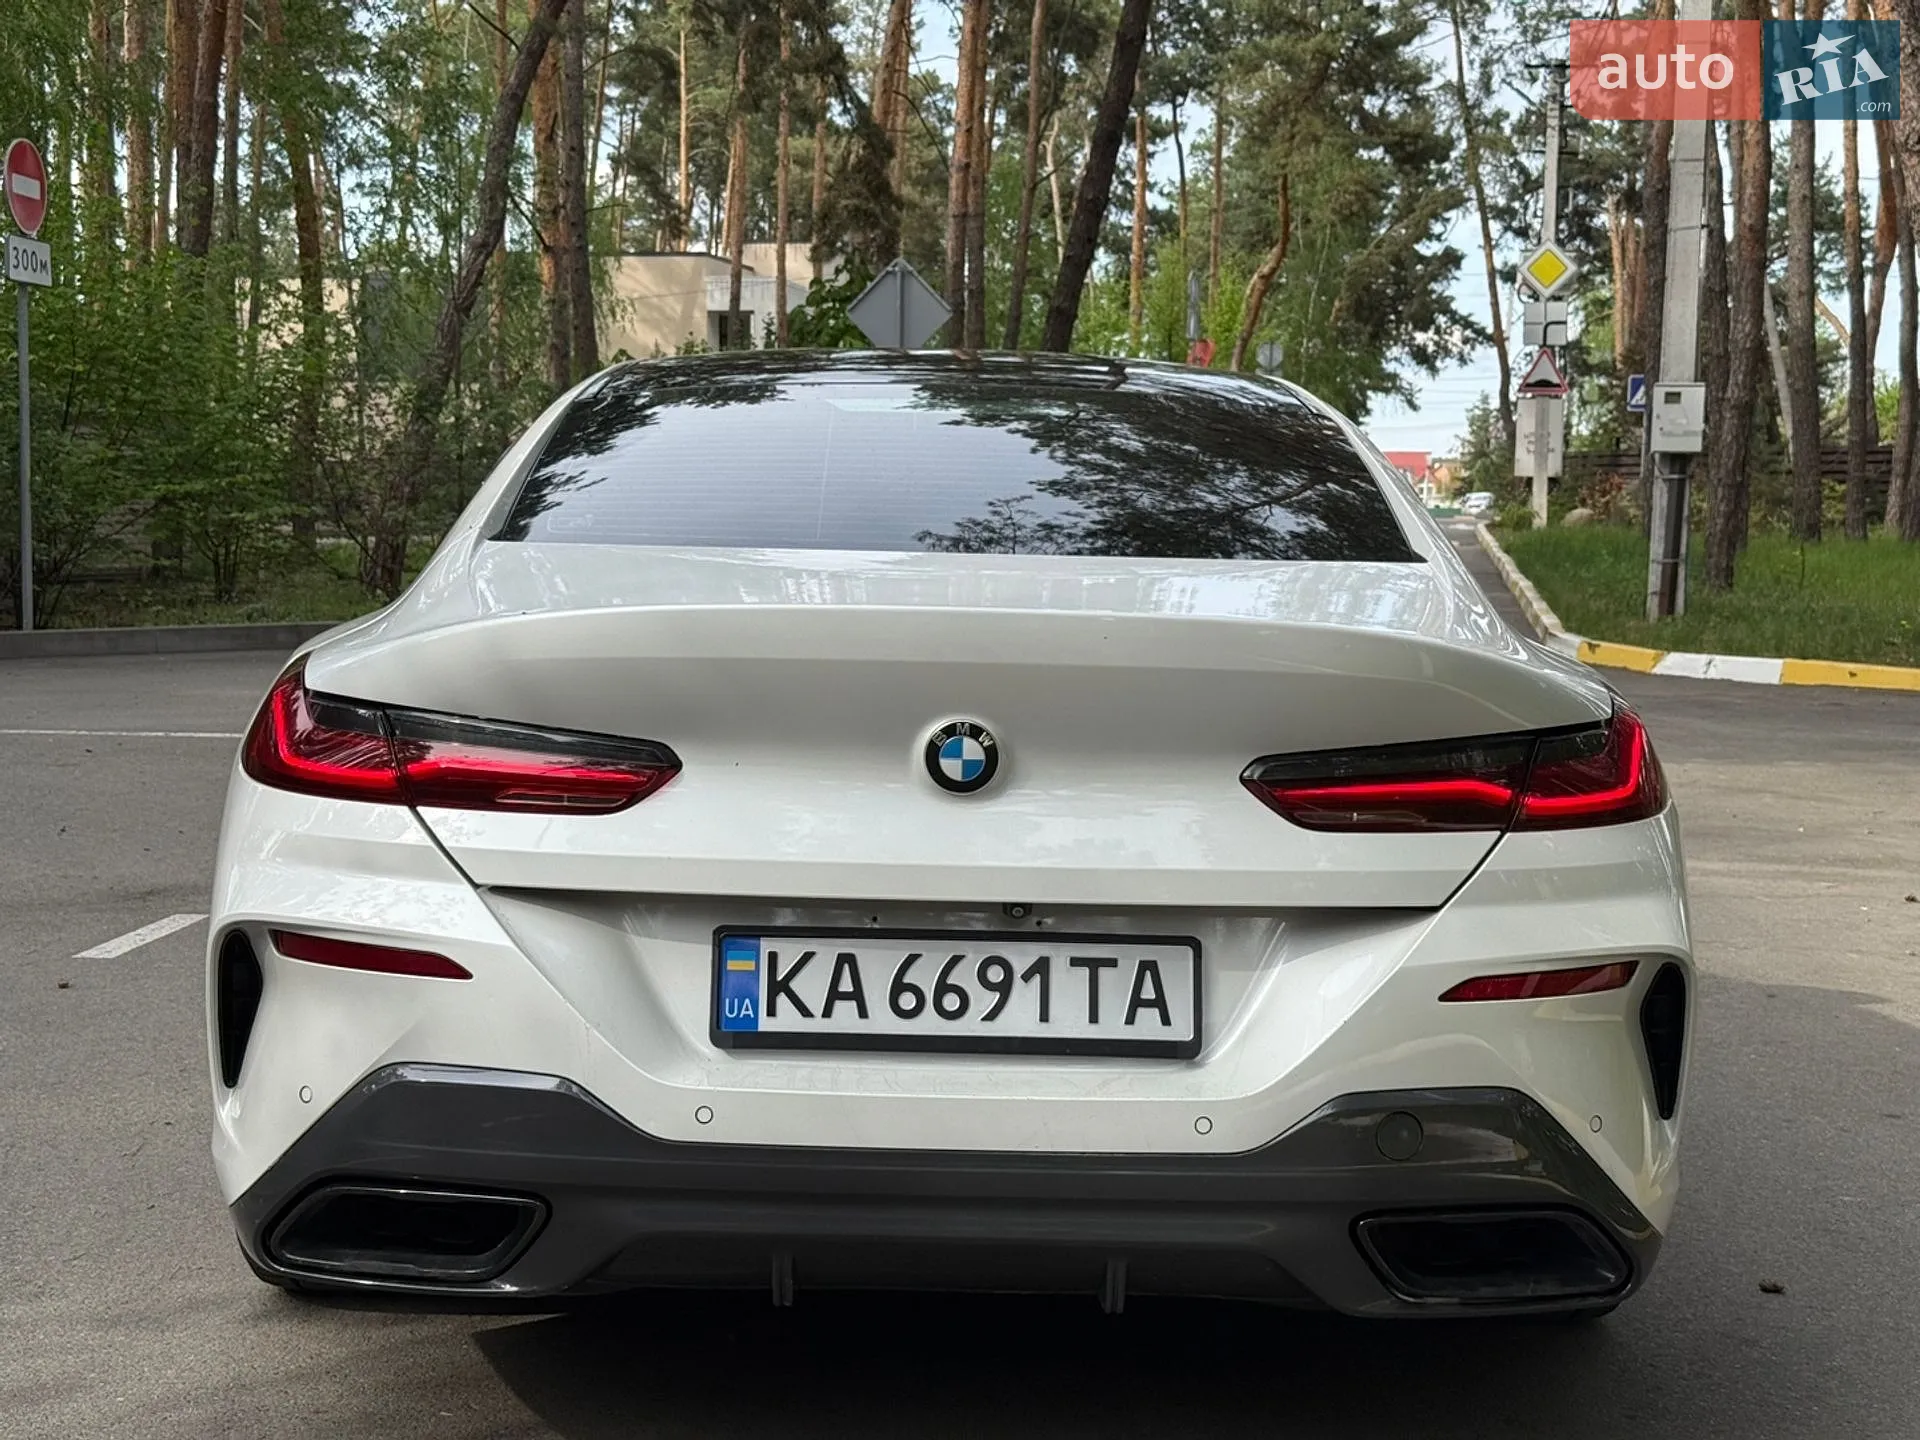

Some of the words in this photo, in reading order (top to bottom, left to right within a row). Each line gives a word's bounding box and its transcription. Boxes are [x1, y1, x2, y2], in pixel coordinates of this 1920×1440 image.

[932, 722, 994, 747] BMW
[766, 951, 870, 1019] KA
[888, 953, 1050, 1023] 6691
[1069, 957, 1172, 1027] TA
[725, 998, 755, 1019] UA
